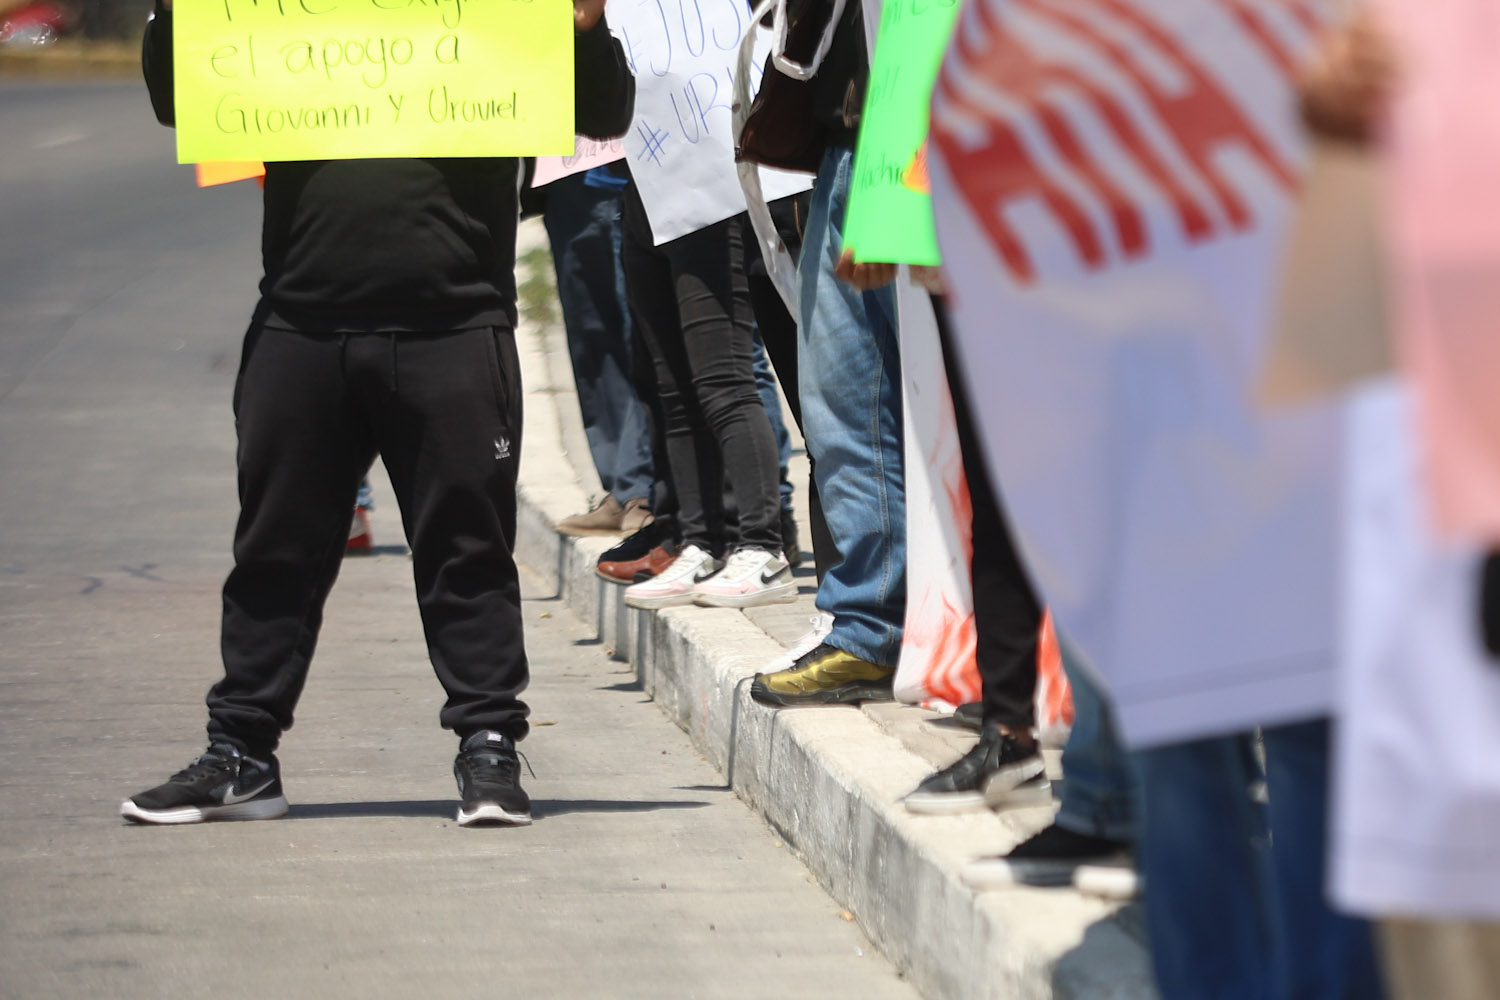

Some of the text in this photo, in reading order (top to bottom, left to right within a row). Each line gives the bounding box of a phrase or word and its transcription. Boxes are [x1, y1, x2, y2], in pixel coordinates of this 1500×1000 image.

[211, 34, 460, 89] el apoyo a
[215, 92, 370, 135] Giovanni
